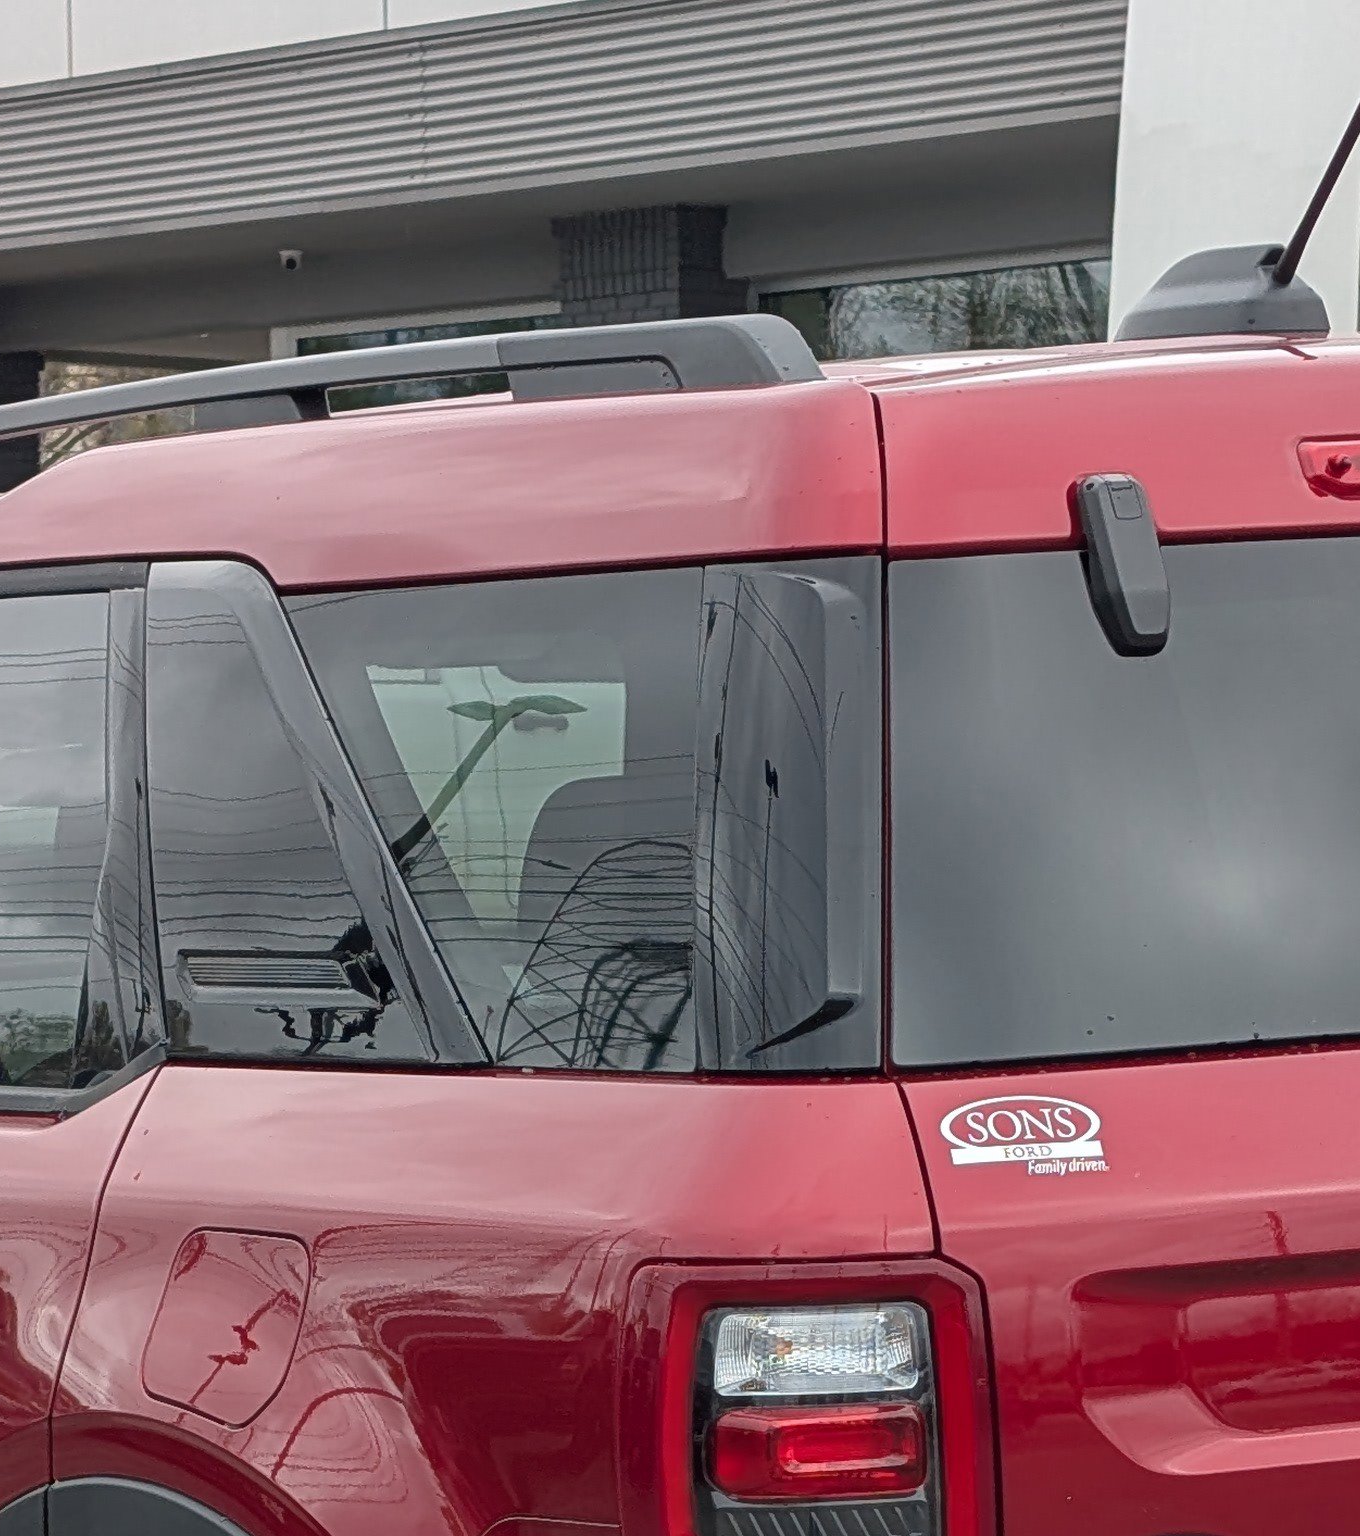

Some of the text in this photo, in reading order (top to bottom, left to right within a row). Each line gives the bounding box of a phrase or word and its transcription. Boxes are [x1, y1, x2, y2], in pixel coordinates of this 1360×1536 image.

[966, 1107, 1077, 1143] SONS
[1003, 1145, 1053, 1159] FORD
[1028, 1159, 1067, 1177] Family
